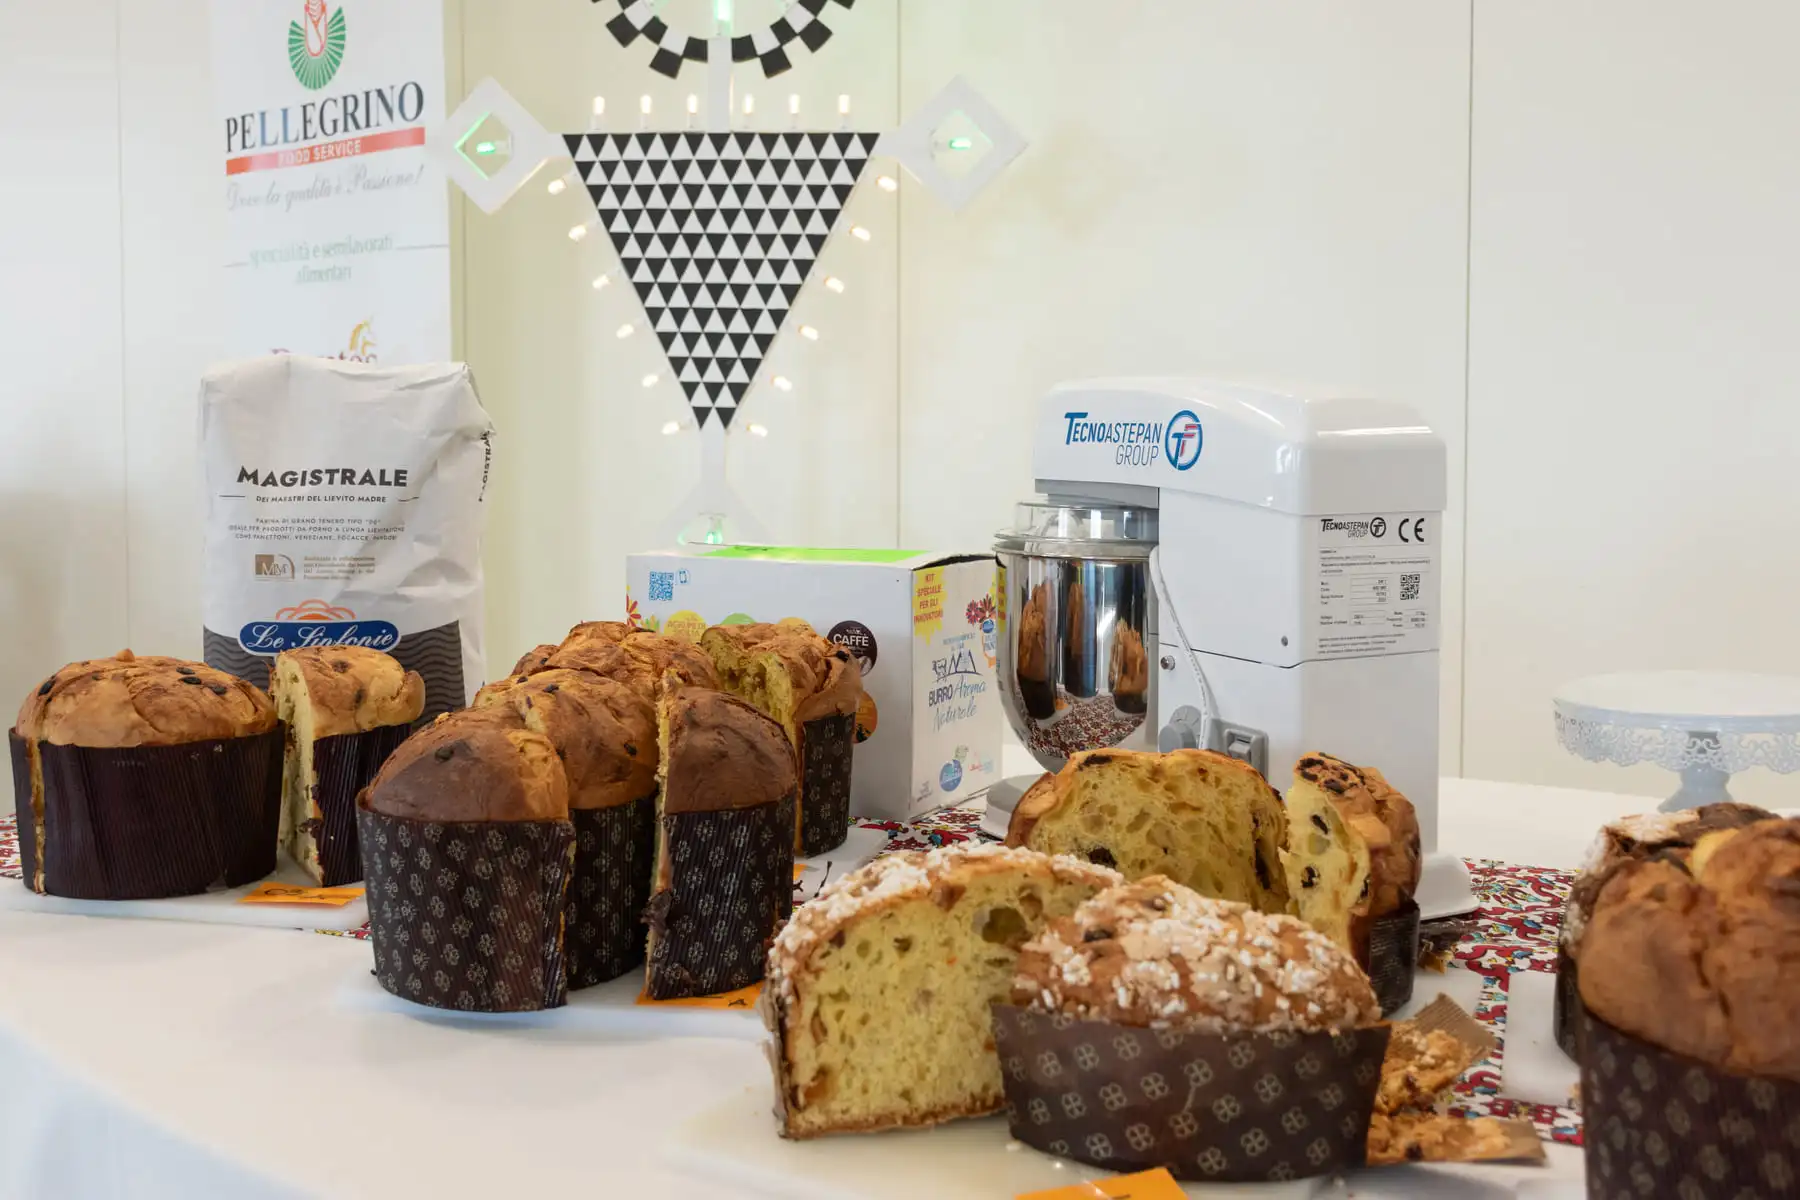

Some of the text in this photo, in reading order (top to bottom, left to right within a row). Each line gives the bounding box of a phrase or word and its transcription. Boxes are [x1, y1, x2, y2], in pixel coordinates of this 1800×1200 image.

[224, 81, 425, 153] PELLEGRINO
[278, 139, 362, 167] FOOD SERVICE
[265, 180, 280, 206] la
[1064, 412, 1162, 445] TECNOASTEPAN
[1115, 444, 1160, 467] GROUP
[237, 466, 409, 488] MAGISTRALE
[256, 495, 270, 503] DEI
[271, 495, 305, 504] MAESTRI
[307, 495, 322, 503] DEL
[324, 495, 355, 503] LIEVITO
[1321, 518, 1369, 533] TECNOASTEPAN
[247, 624, 285, 649] Le
[928, 674, 986, 708] BURRO Aroma
